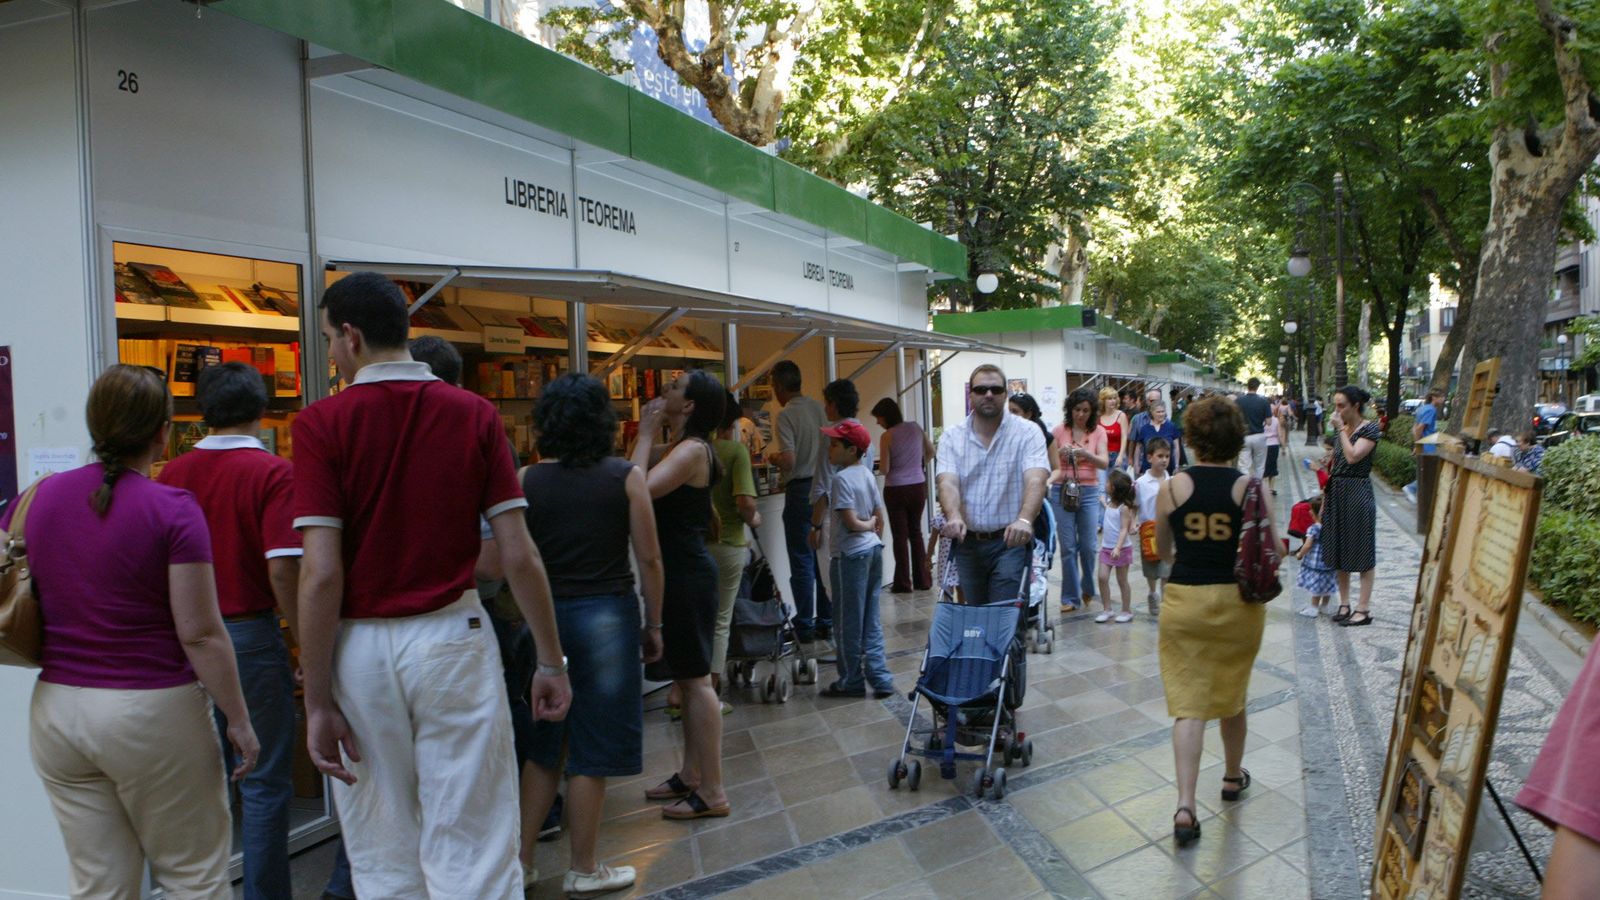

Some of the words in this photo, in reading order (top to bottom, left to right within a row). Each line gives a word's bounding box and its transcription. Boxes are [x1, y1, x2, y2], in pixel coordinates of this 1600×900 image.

[118, 69, 139, 94] 26
[683, 86, 701, 108] en
[504, 177, 568, 219] LIBRERIA
[578, 196, 637, 235] TEOREMA
[829, 269, 854, 291] TEOREMA
[1184, 512, 1232, 541] 96
